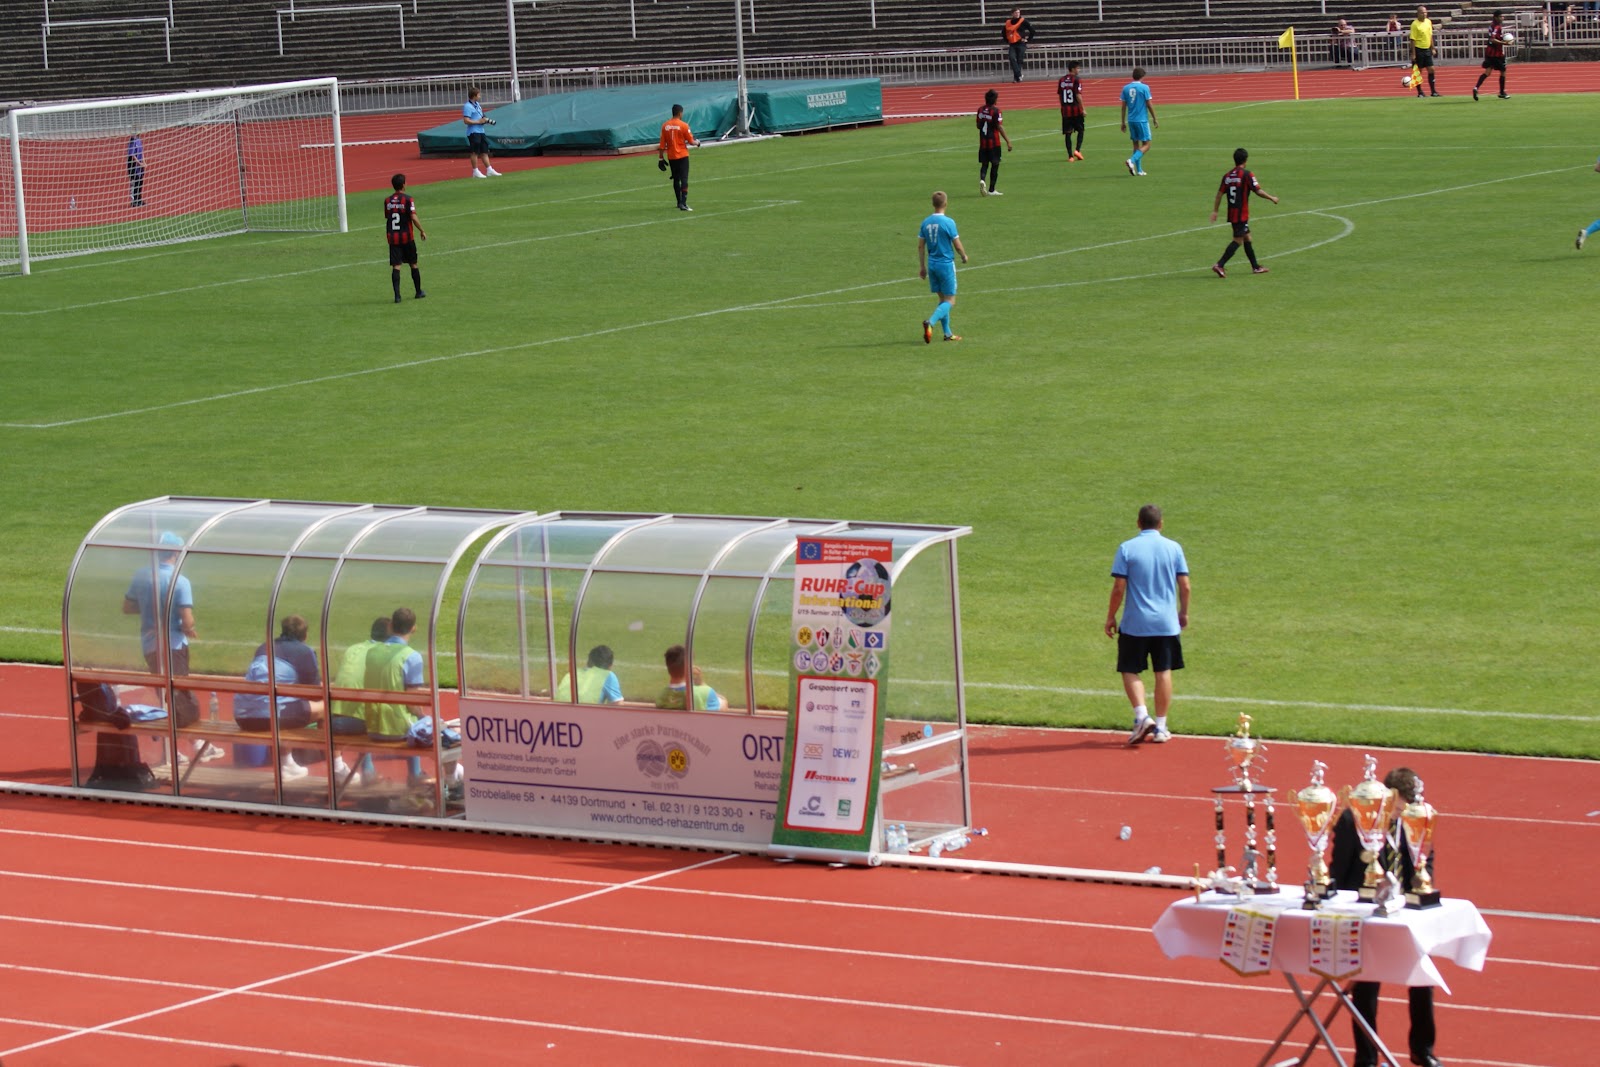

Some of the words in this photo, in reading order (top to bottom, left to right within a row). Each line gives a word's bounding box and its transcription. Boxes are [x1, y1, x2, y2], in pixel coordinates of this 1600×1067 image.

[1063, 89, 1074, 103] 13
[1129, 88, 1137, 103] 9
[982, 121, 988, 136] 4
[1229, 186, 1236, 204] 5
[391, 213, 400, 230] 2
[926, 224, 939, 243] 17
[800, 577, 885, 598] RUHR-Cup
[799, 594, 883, 609] International
[797, 608, 830, 616] U19-Turnier
[809, 683, 848, 693] Gesponsert
[465, 715, 583, 753] ORTHOMED
[900, 730, 921, 745] artec
[742, 733, 784, 762] ORT
[832, 748, 860, 759] DEW21
[476, 750, 524, 762] Medizinisches
[525, 753, 559, 766] Leistungs-
[562, 756, 576, 765] und
[477, 761, 551, 774] Rehabilitationszentrum
[554, 766, 577, 776] GmbH
[470, 787, 521, 801] Strobelallee
[523, 792, 535, 802] 58
[551, 795, 578, 806] 44139
[581, 796, 626, 809] Dortmund
[642, 801, 657, 811] Tel.
[660, 802, 672, 813] 02
[674, 803, 685, 814] 31
[693, 805, 700, 815] 9
[703, 806, 720, 816] 123
[722, 807, 743, 818] 30-0
[760, 809, 777, 820] Fax
[590, 813, 745, 833] www.orthomed-rehazentrum.de
